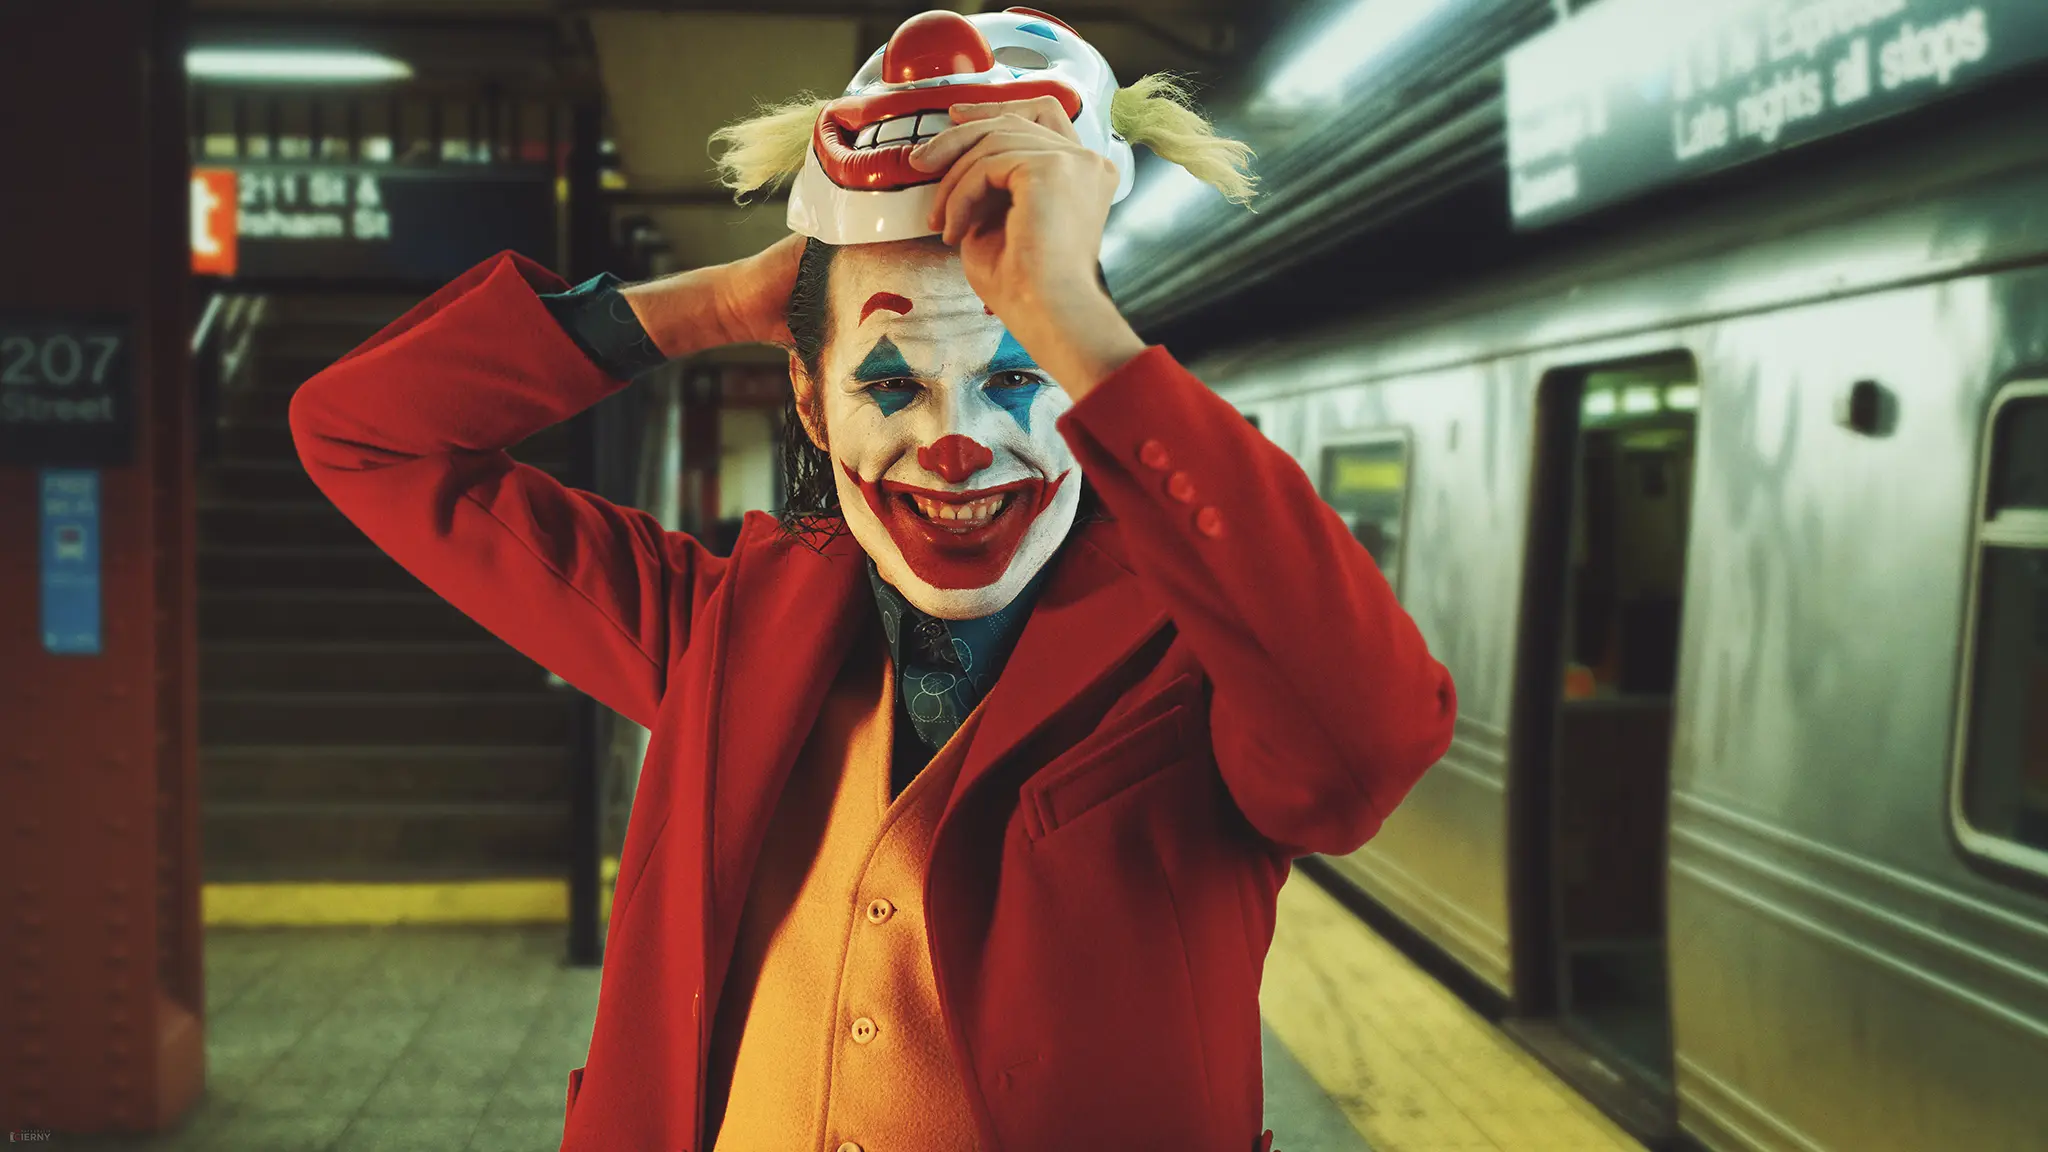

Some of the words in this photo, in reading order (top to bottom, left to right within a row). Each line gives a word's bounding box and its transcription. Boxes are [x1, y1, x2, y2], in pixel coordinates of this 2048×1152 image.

[1672, 107, 1729, 161] Late
[1736, 67, 1823, 144] nights
[1831, 36, 1871, 106] all
[1879, 7, 1988, 90] stops
[239, 171, 296, 206] 211
[309, 171, 346, 206] St
[353, 207, 390, 239] St
[1, 334, 120, 386] 207
[1, 391, 114, 421] Street
